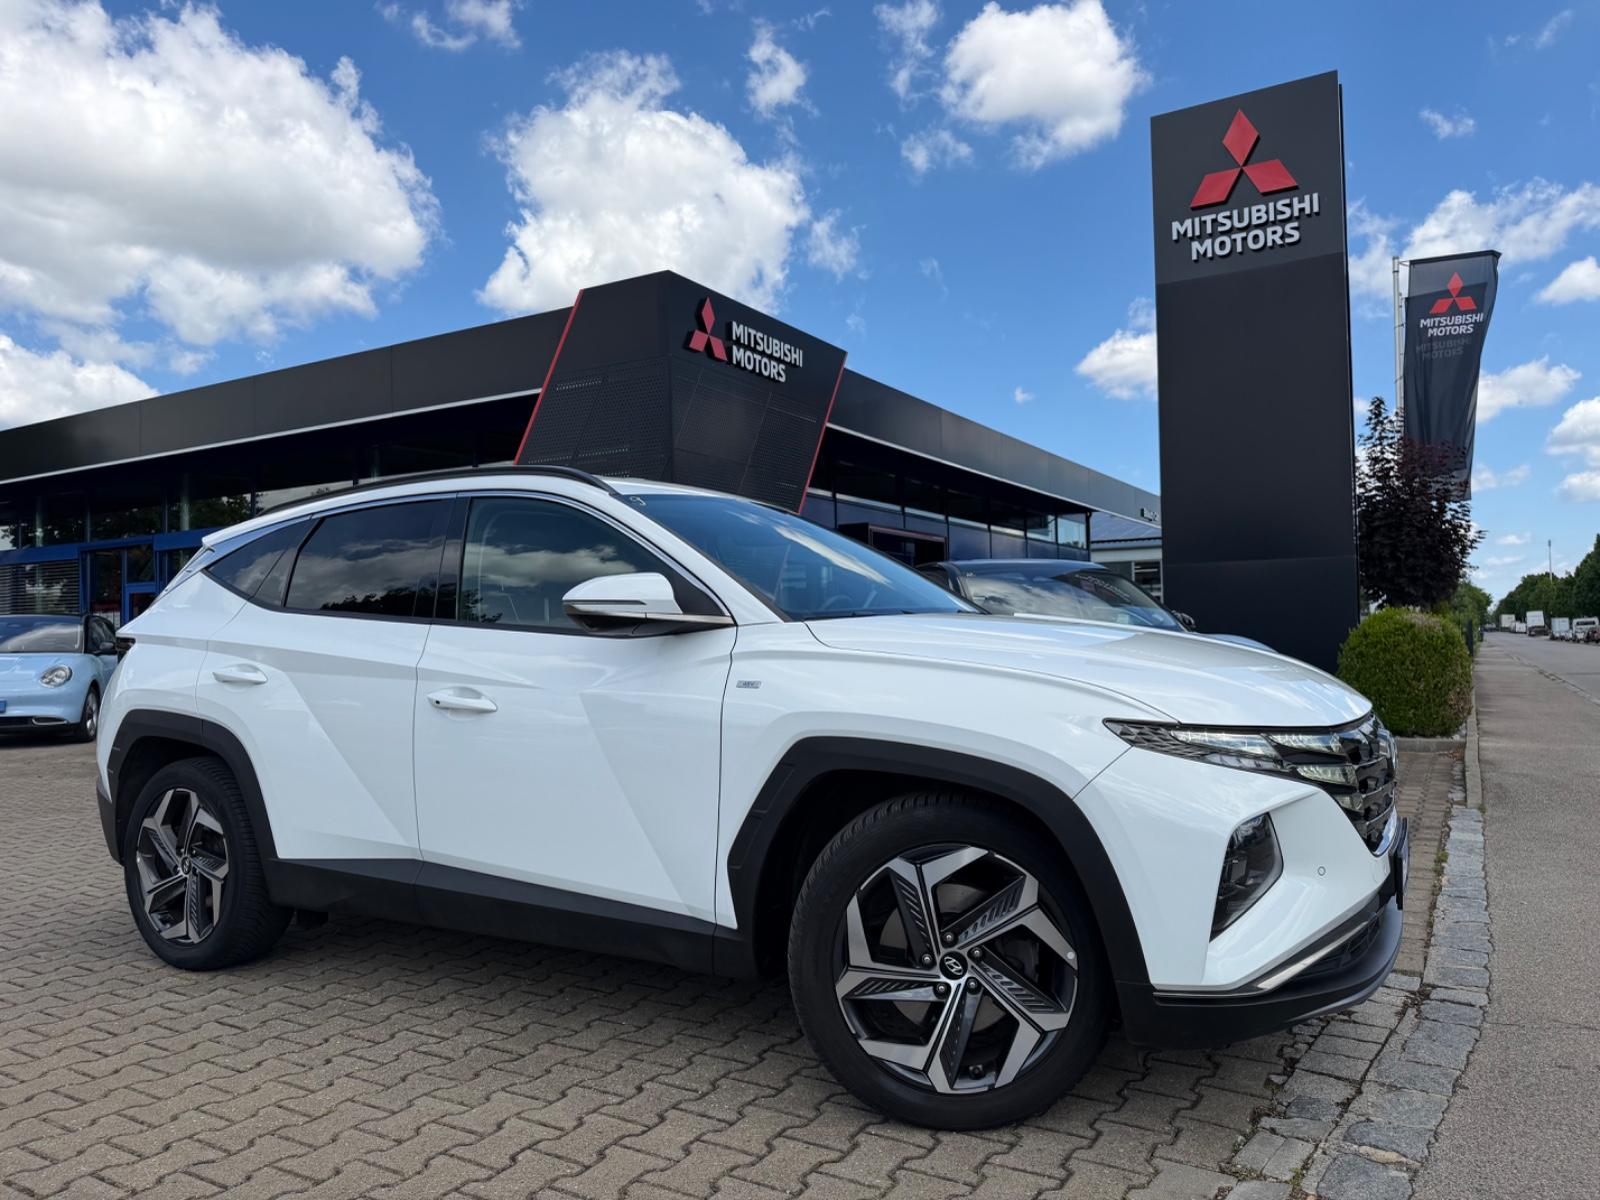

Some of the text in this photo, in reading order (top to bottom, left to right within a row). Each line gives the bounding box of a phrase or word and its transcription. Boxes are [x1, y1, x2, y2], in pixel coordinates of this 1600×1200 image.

[1171, 192, 1321, 241] MITSUBISHI
[1191, 222, 1301, 261] MOTORS
[1419, 312, 1484, 328] MITSUBISHI
[1427, 324, 1474, 337] MOTORS
[731, 320, 803, 368] MITSUBISHI
[732, 345, 786, 383] MOTORS
